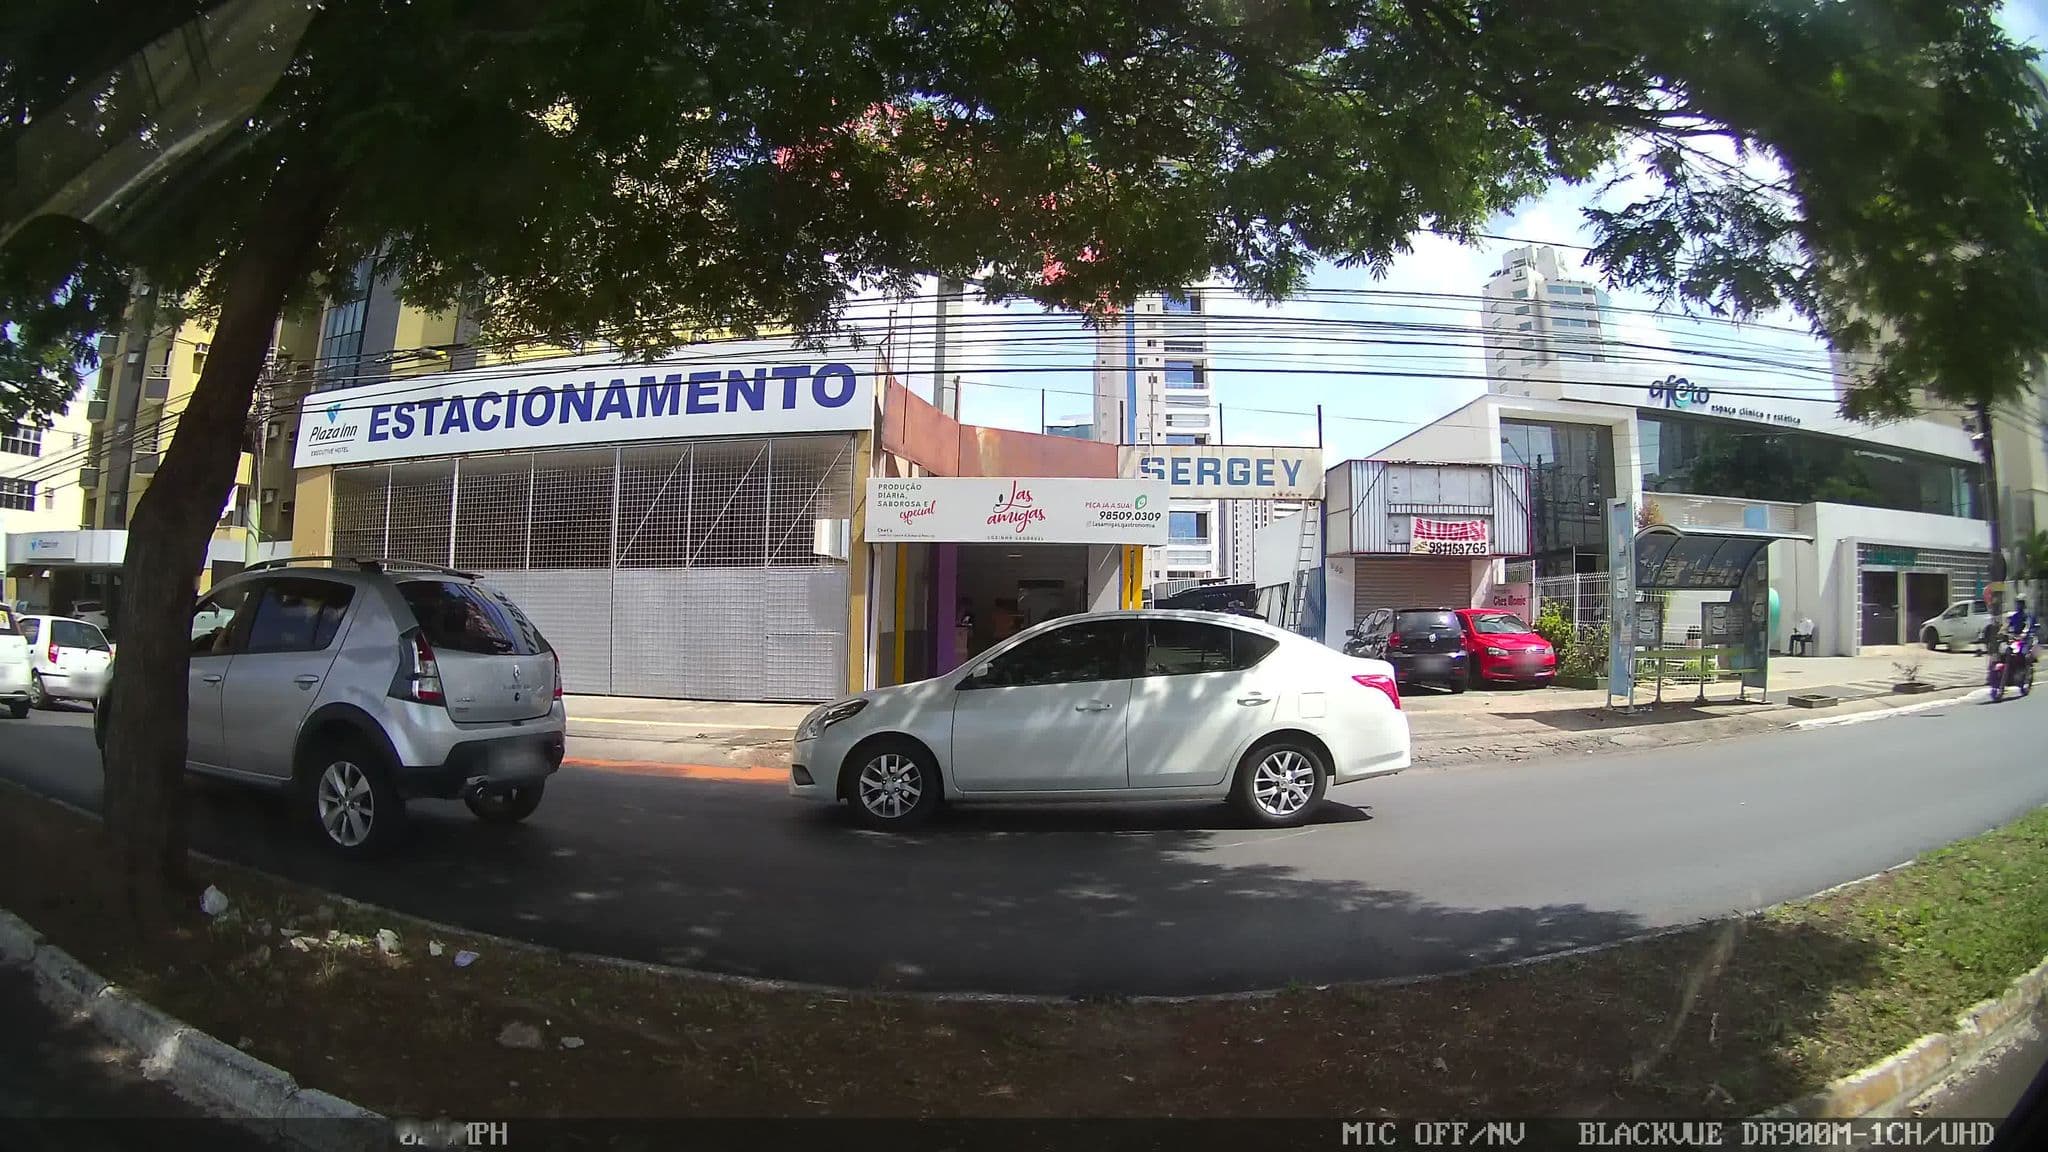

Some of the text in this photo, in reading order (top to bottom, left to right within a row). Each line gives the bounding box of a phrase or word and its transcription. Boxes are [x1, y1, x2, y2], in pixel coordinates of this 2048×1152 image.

[367, 363, 856, 442] ESTACIONAMENTO
[1649, 374, 1710, 408] afeto
[1711, 404, 1736, 416] espaço
[309, 423, 358, 442] Plaza Inn
[1141, 457, 1303, 486] SERGEY
[878, 482, 922, 491] PRODUÇÃO
[993, 480, 1033, 513] Las
[987, 508, 1046, 533] amigas
[1099, 511, 1162, 521] 98509.0309
